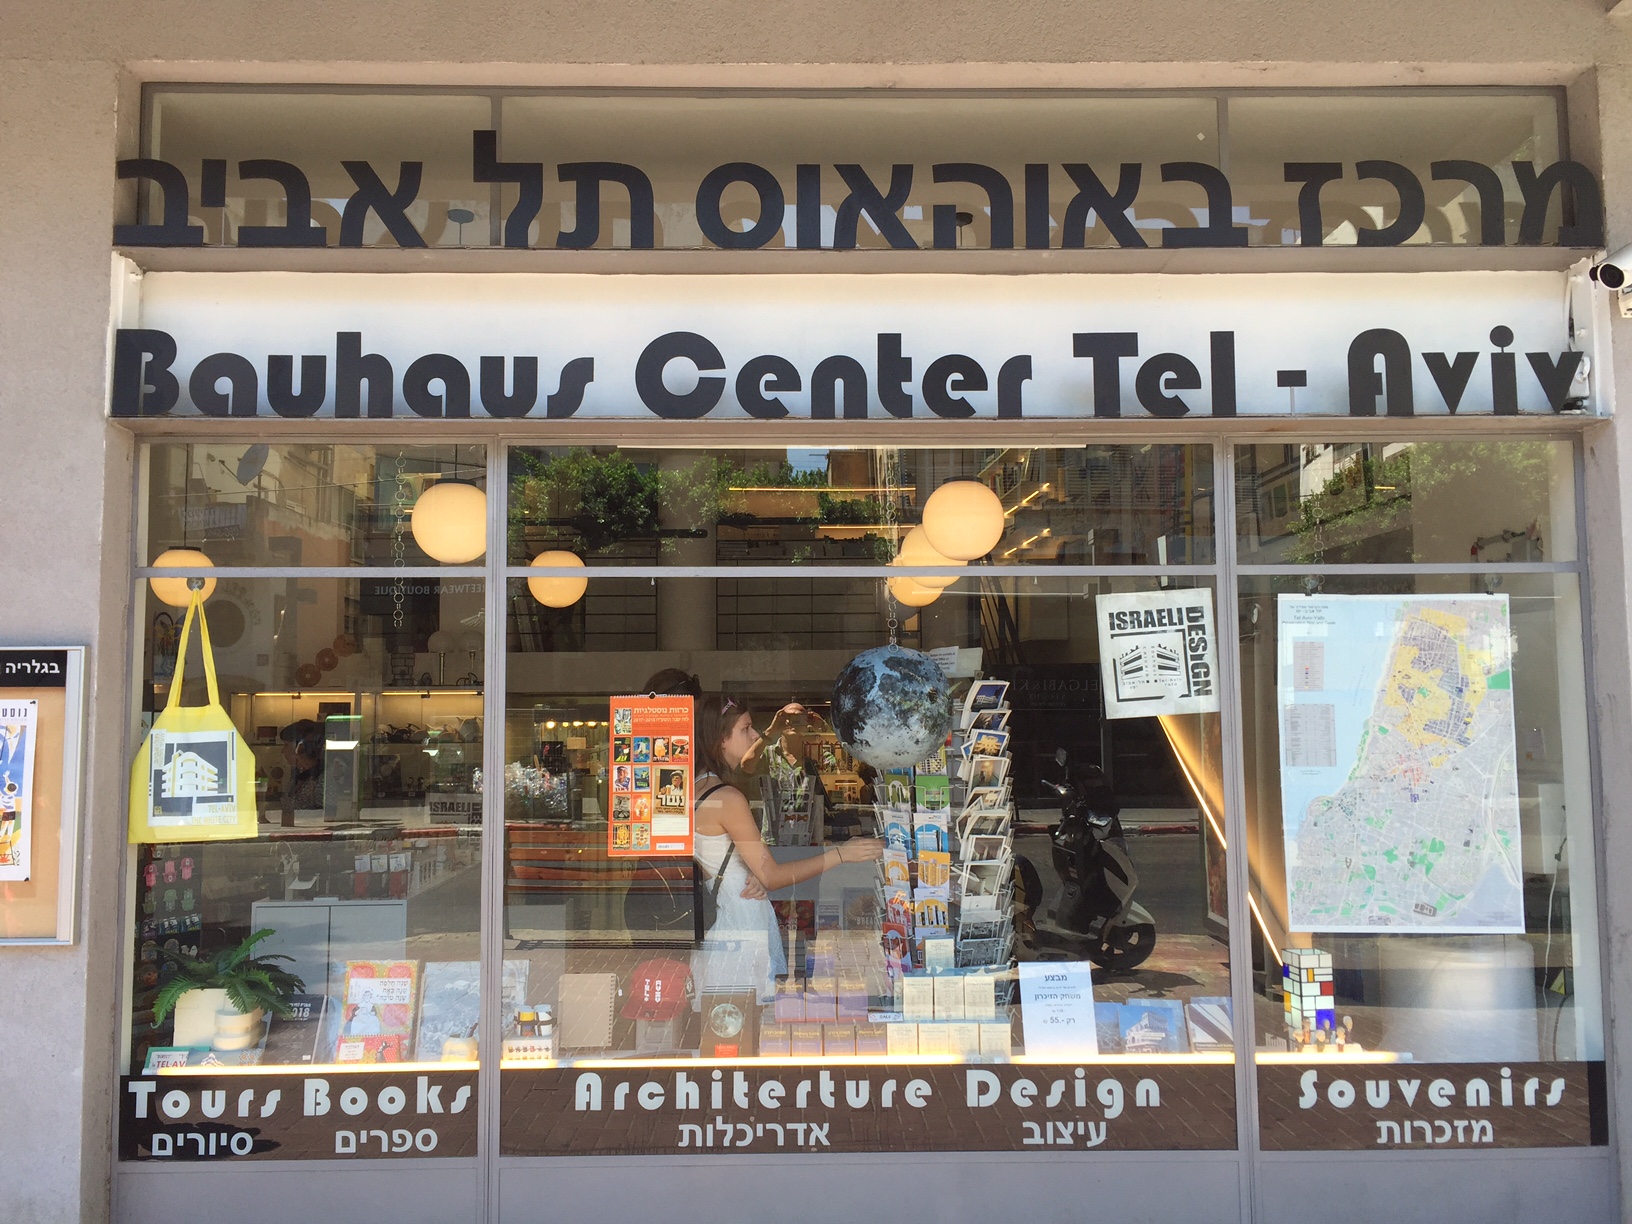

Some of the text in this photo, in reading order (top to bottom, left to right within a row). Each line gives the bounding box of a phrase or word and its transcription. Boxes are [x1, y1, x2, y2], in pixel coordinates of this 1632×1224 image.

[113, 130, 1605, 249] מרכז באוהאוס תל אביב
[112, 329, 594, 419] Bauhaus
[635, 331, 1032, 420] Center
[1072, 330, 1236, 418] Tel
[1347, 325, 1583, 417] Aviv
[1108, 607, 1184, 631] ISRAELI
[5, 659, 60, 674] בגלריה
[1185, 606, 1212, 697] DESIGN
[429, 802, 471, 812] ISRAELI
[1060, 993, 1081, 1001] משחק
[128, 1076, 472, 1119] Tours Books
[575, 1067, 1161, 1120] Architerture Design
[1298, 1067, 1565, 1109] Souvenirs
[152, 1128, 438, 1157] סיורים ספרים
[678, 1115, 1108, 1148] אדריכלות עיצוב
[1376, 1119, 1494, 1145] מזכרות
